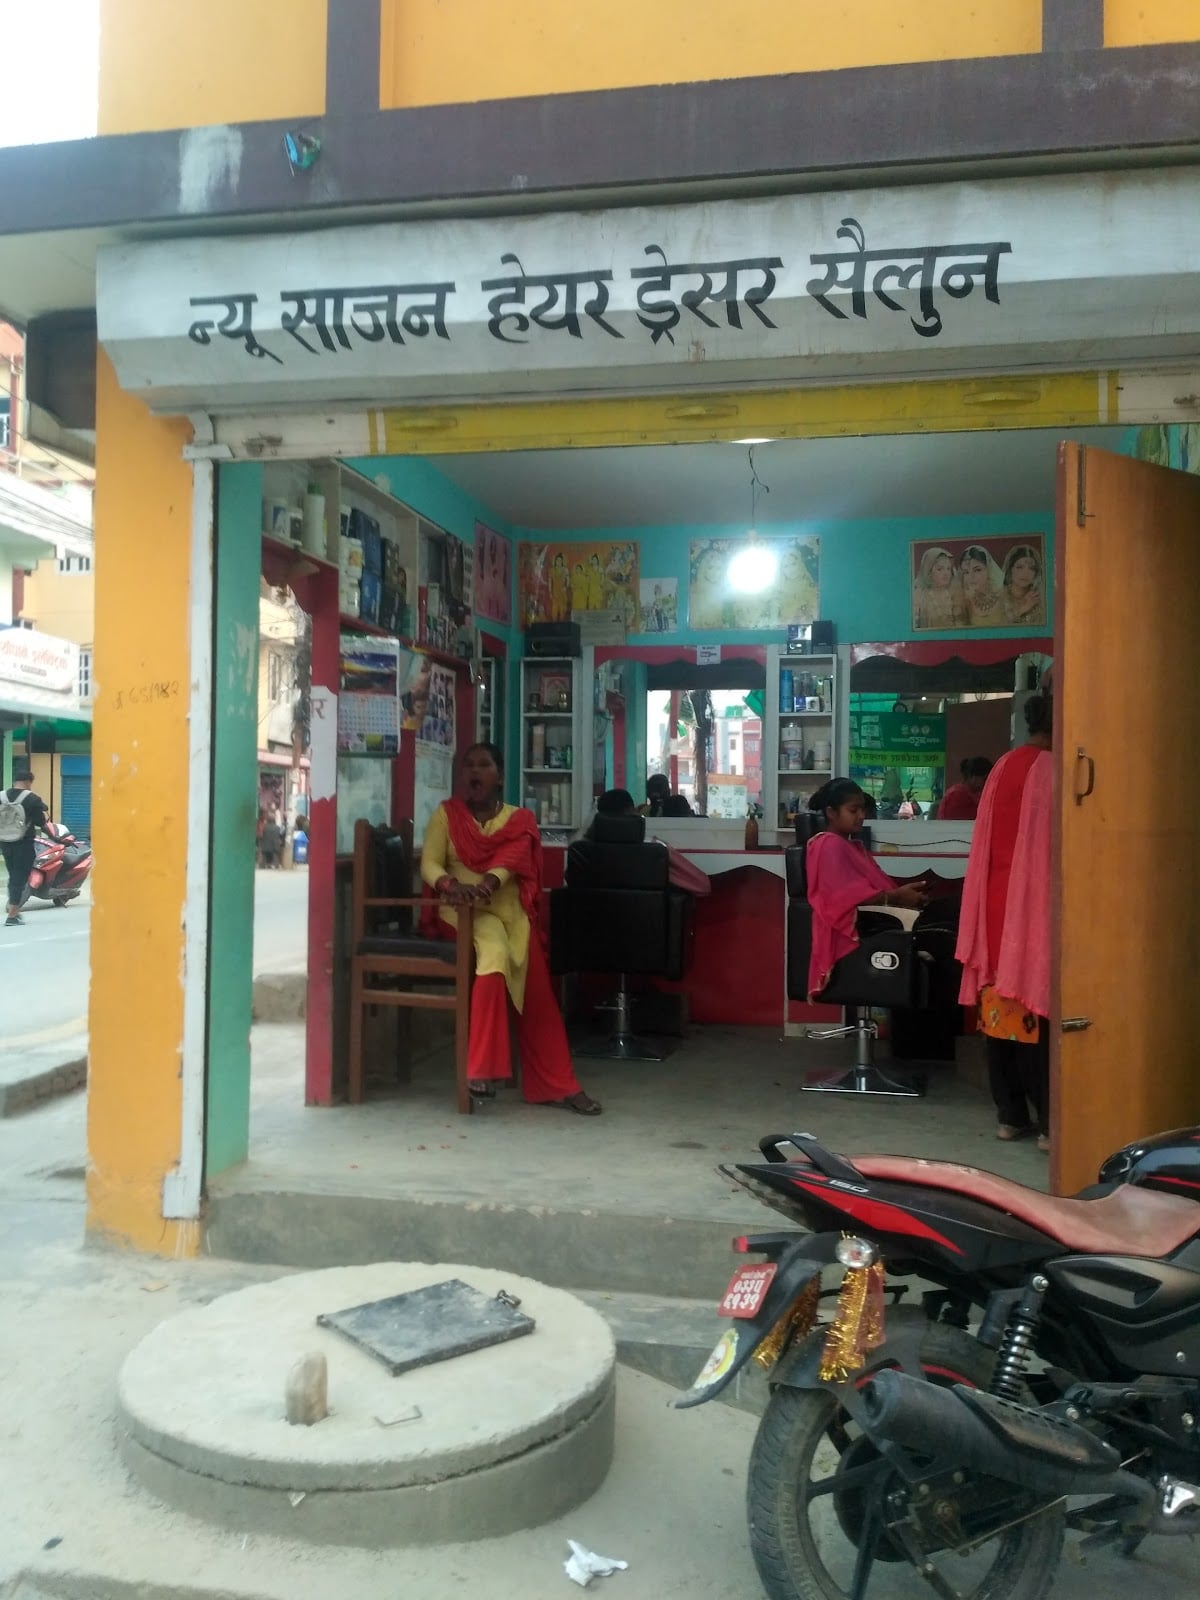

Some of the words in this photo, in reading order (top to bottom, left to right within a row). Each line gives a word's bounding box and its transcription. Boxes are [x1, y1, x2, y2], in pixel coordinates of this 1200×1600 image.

[188, 293, 284, 364] न्यू
[280, 281, 456, 354] साजन
[481, 252, 626, 344] हेयर
[630, 244, 784, 346] ड्रेसर
[805, 217, 1012, 338] सैलुन
